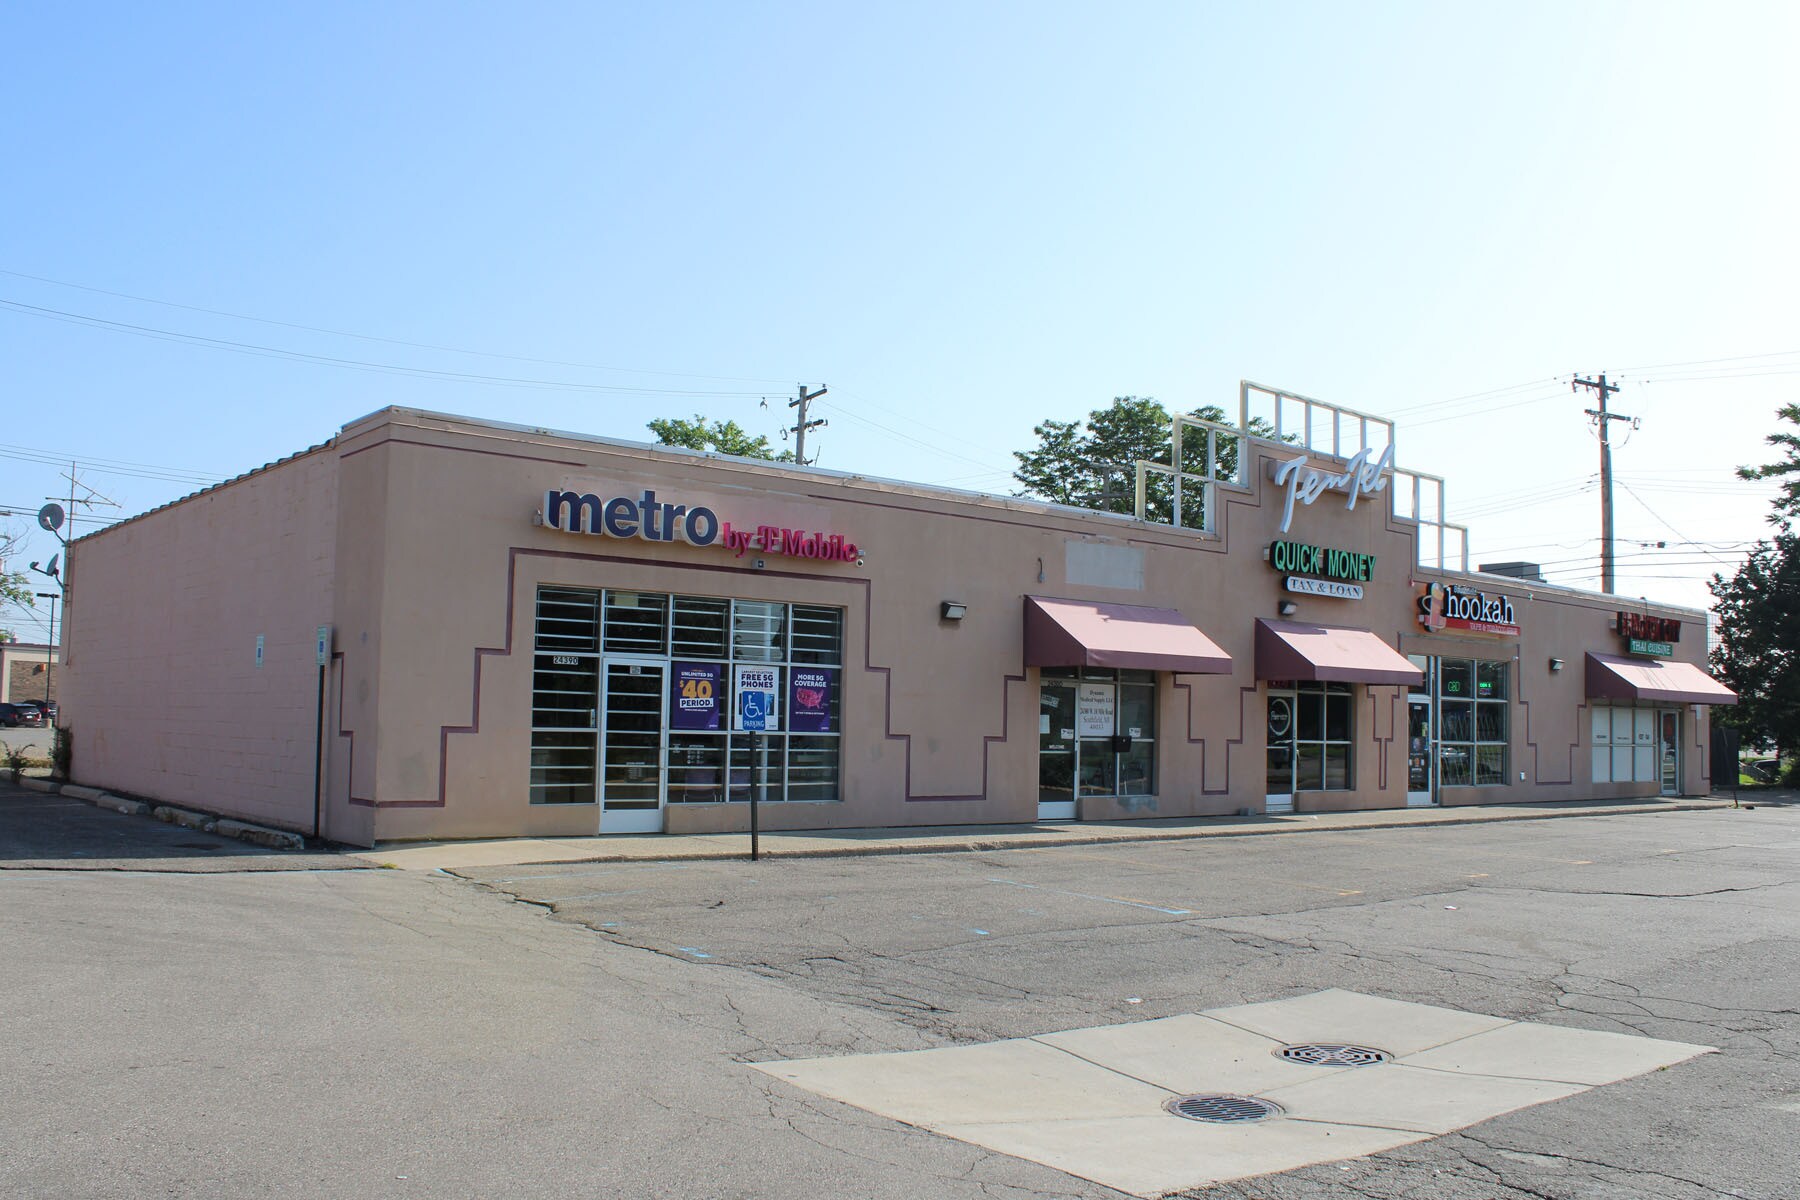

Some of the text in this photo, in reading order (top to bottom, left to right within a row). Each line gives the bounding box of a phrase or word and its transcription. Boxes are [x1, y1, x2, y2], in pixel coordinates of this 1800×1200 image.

[543, 489, 719, 547] metro
[722, 522, 752, 558] by
[1274, 540, 1377, 582] QUICK MONEY
[1290, 579, 1361, 597] TAX & LOAN
[1446, 587, 1516, 625] hookah
[1632, 641, 1671, 656] THAI CUISINE
[553, 656, 578, 665] 24390
[741, 673, 774, 682] FREE 5G
[741, 680, 774, 689] PHONES
[679, 679, 713, 698] $40
[681, 699, 713, 707] PERIOD.
[743, 720, 765, 728] PARKING
